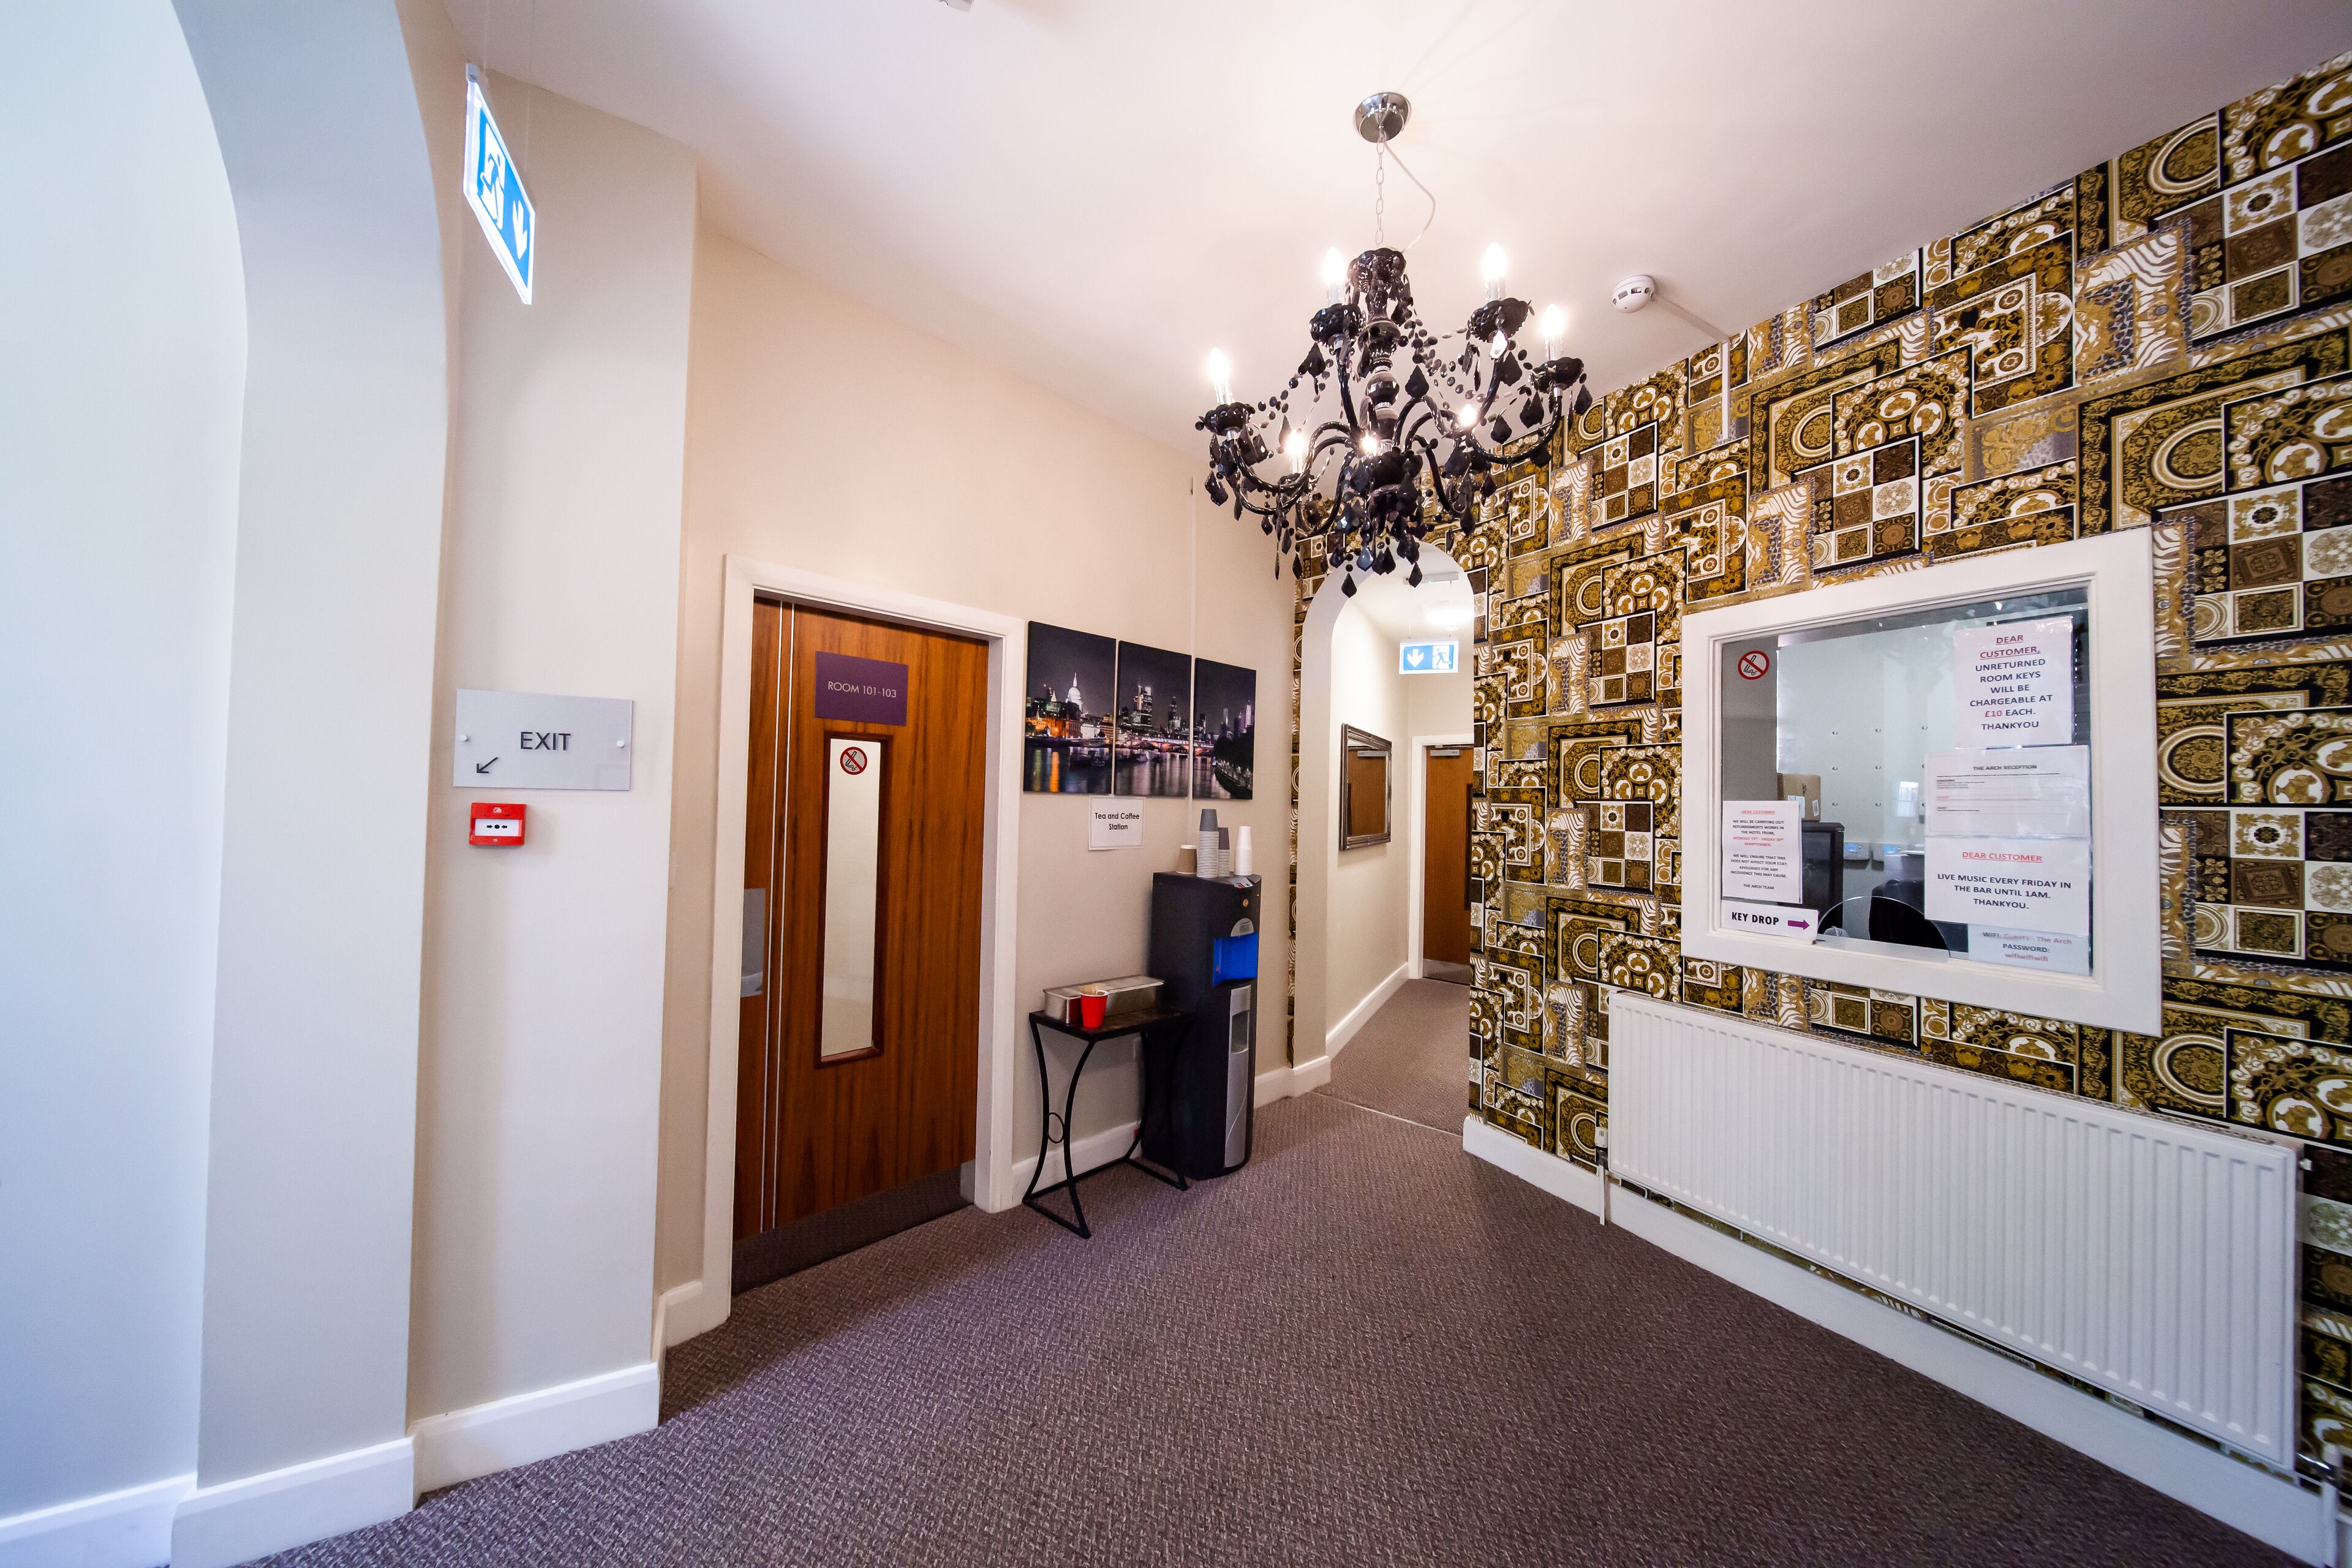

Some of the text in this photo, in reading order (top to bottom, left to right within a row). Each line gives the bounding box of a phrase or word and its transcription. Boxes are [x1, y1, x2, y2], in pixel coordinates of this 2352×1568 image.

[1996, 635, 2024, 644] DEAR
[1980, 646, 2041, 658] CUSTOMER,
[1975, 659, 2046, 671] UNRETURNED
[1980, 671, 2041, 683] ROOM KEYS
[828, 681, 897, 698] ROOM 101-103
[1970, 696, 2035, 707] CHARGEABLE
[1981, 721, 2039, 730] THANKYOU
[520, 731, 571, 750] EXIT
[1989, 853, 2042, 862] CUSTOMER
[2022, 879, 2057, 888] FRIDAY
[1973, 898, 2029, 909] THANKYOU.
[1732, 912, 1779, 925] KEY DROP
[2003, 943, 2050, 952] PASSWORD:
